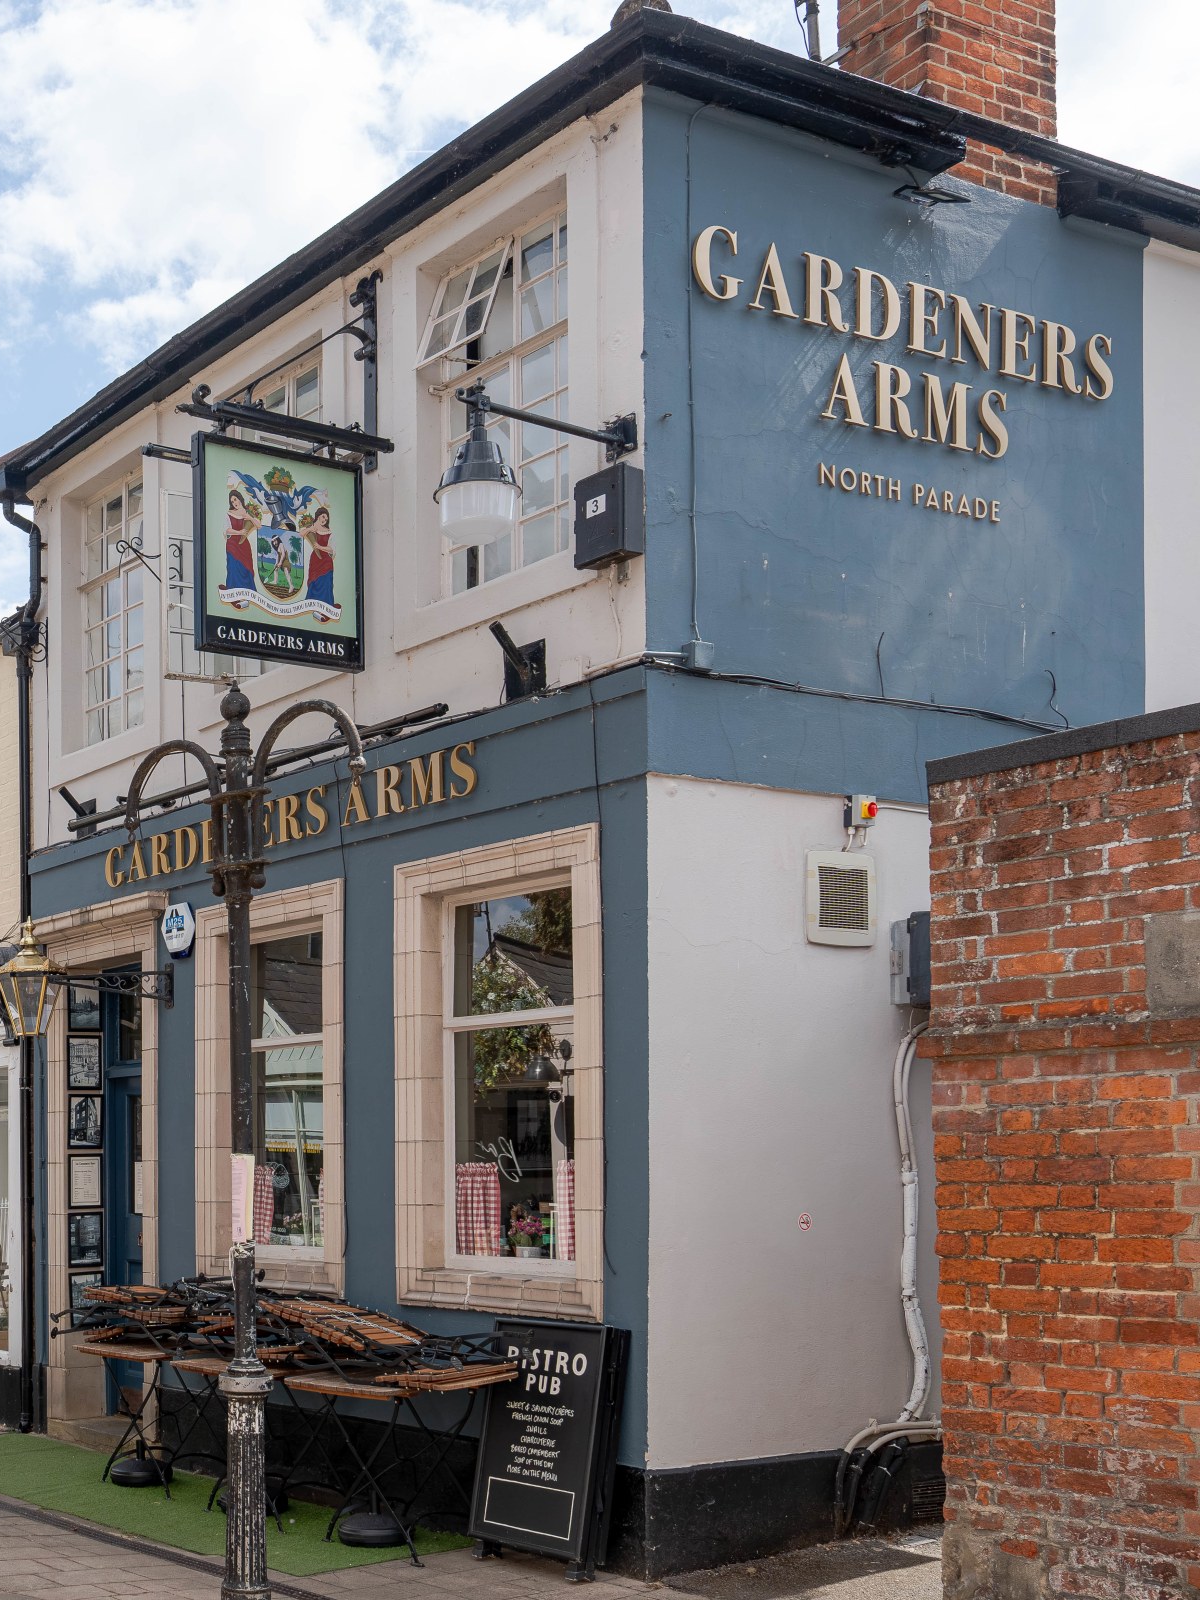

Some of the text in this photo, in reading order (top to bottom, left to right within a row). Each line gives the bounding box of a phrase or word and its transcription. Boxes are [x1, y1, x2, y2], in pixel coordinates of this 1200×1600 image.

[692, 225, 1114, 400] GARDENERS
[821, 353, 1008, 459] ARMS
[818, 462, 1001, 523] NORTH PARADE
[591, 499, 599, 513] 3
[217, 625, 345, 657] GARDENERS ARMS
[104, 741, 478, 889] GARDEERS ARMS
[167, 917, 183, 928] M25
[525, 1373, 561, 1395] PUB
[506, 1400, 526, 1411] SWEET
[531, 1404, 556, 1416] SAVOURY
[511, 1411, 564, 1426] FRENCH ONION SOUP
[510, 1443, 527, 1454] BAKED
[513, 1455, 554, 1470] SOUP OF THE DAY
[529, 1469, 541, 1478] THE
